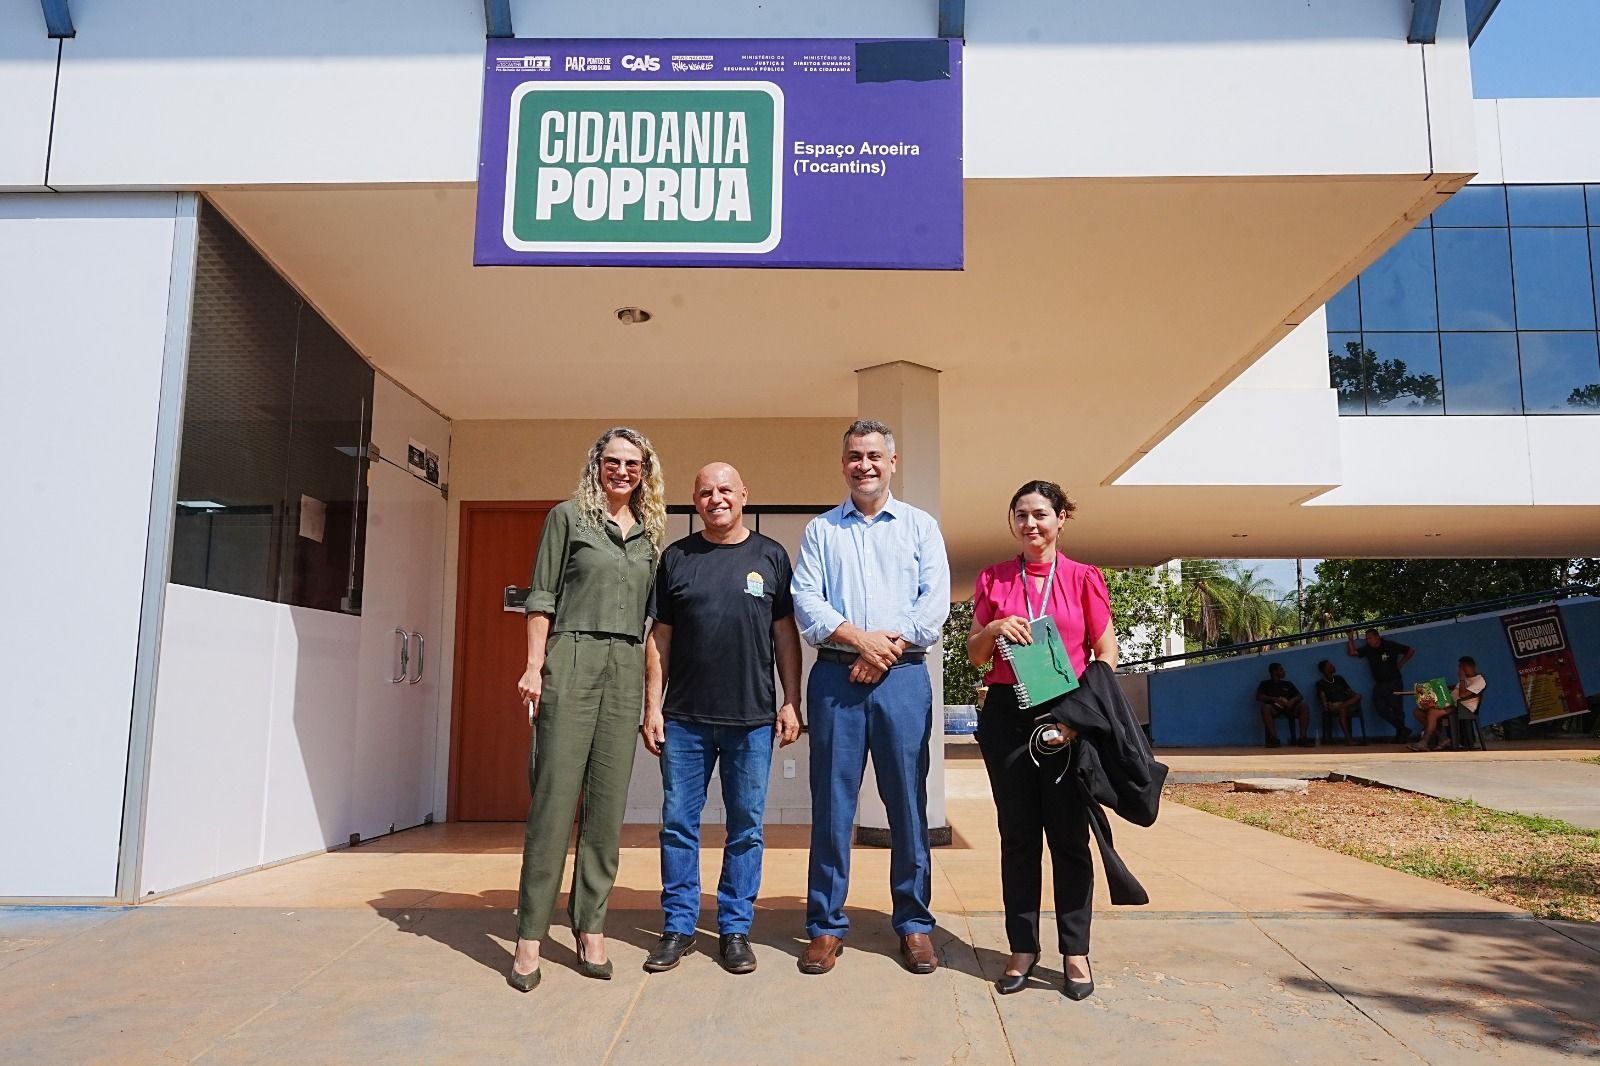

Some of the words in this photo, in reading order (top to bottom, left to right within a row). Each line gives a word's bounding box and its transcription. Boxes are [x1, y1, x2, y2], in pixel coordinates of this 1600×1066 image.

[527, 59, 547, 67] UFT
[565, 56, 586, 72] PAR
[586, 57, 604, 65] PONTOS
[604, 57, 612, 65] DE
[539, 109, 749, 164] CIDADANIA
[794, 141, 855, 159] Espaço
[861, 141, 920, 156] Aroeira
[793, 159, 887, 177] (Tocantins)
[536, 166, 752, 222] POPRUA
[1514, 622, 1557, 642] CIDADANIA
[1518, 634, 1560, 653] POPRUA
